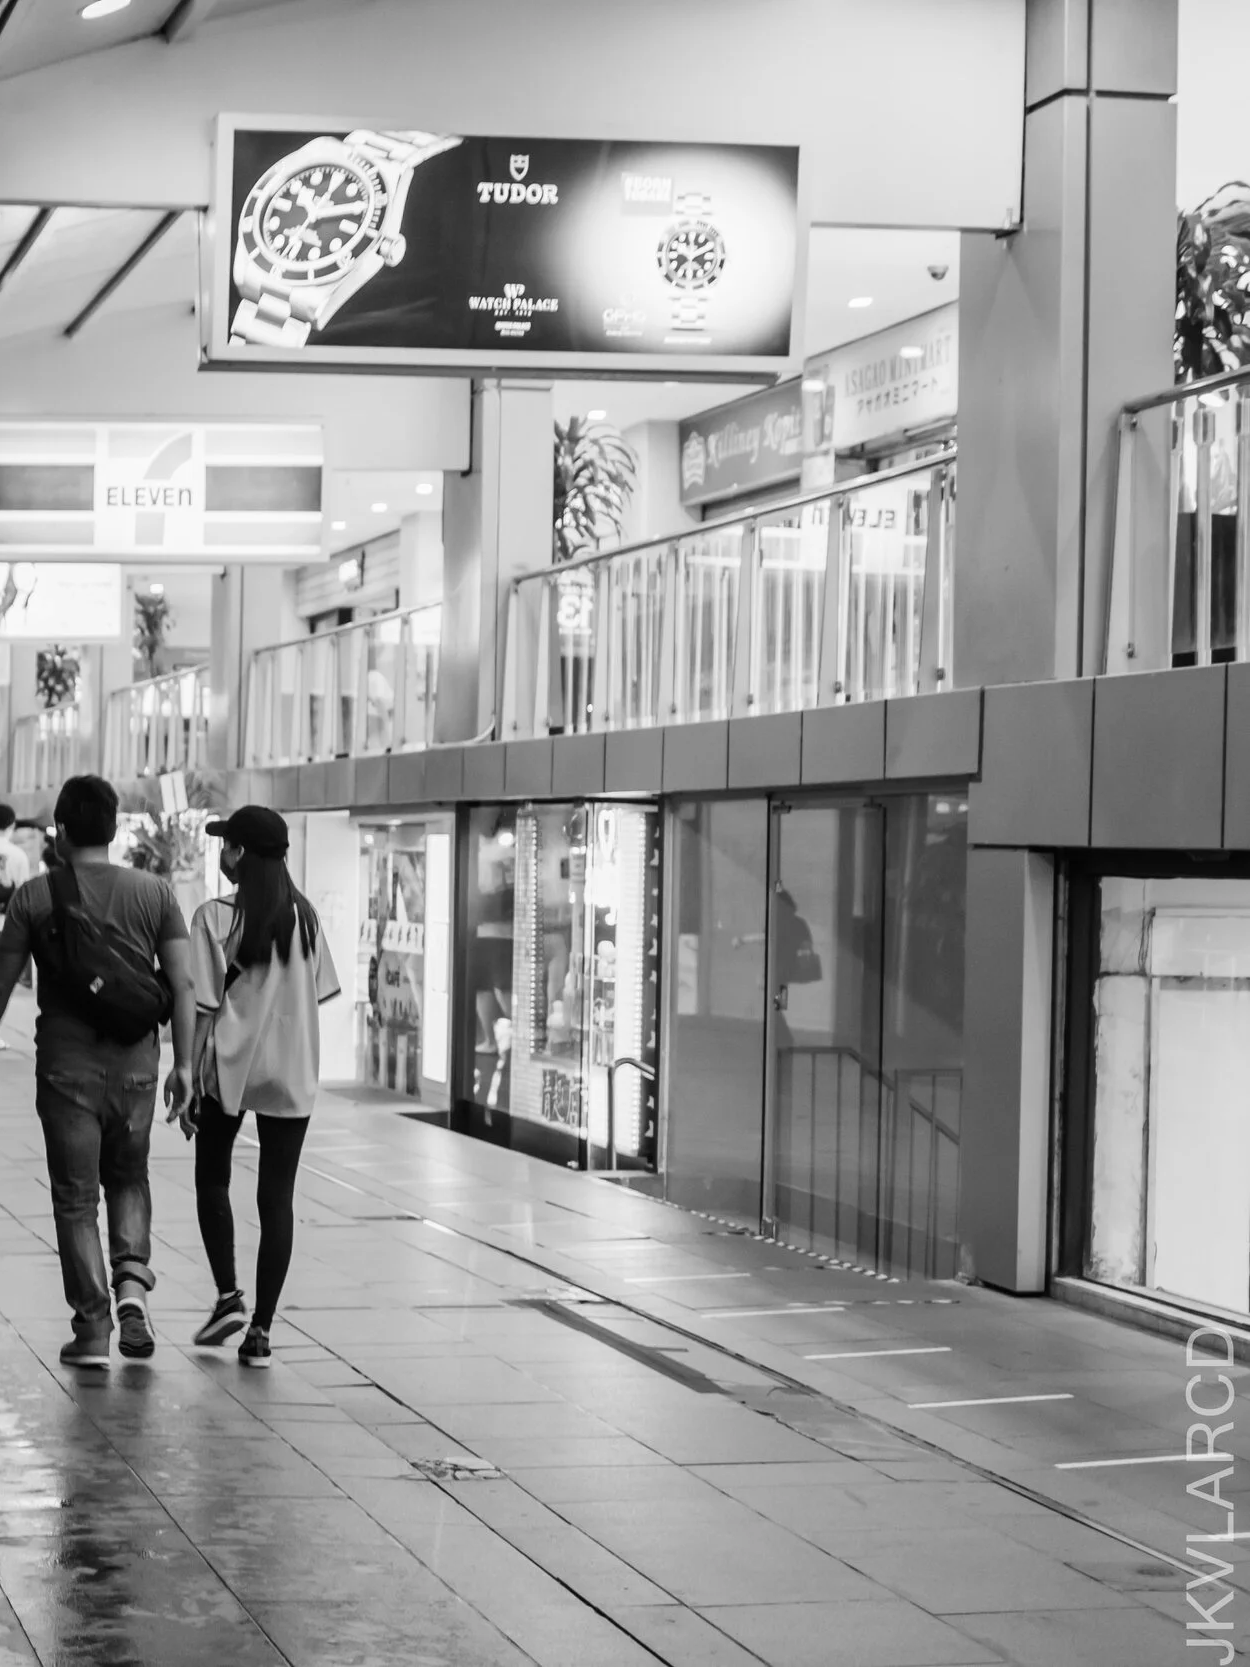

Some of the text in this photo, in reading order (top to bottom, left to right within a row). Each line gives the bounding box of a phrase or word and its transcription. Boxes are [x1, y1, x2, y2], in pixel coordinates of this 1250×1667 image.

[477, 181, 559, 205] TUDOR
[468, 296, 559, 313] WATCH PALACE
[106, 486, 193, 507] ELEVEn
